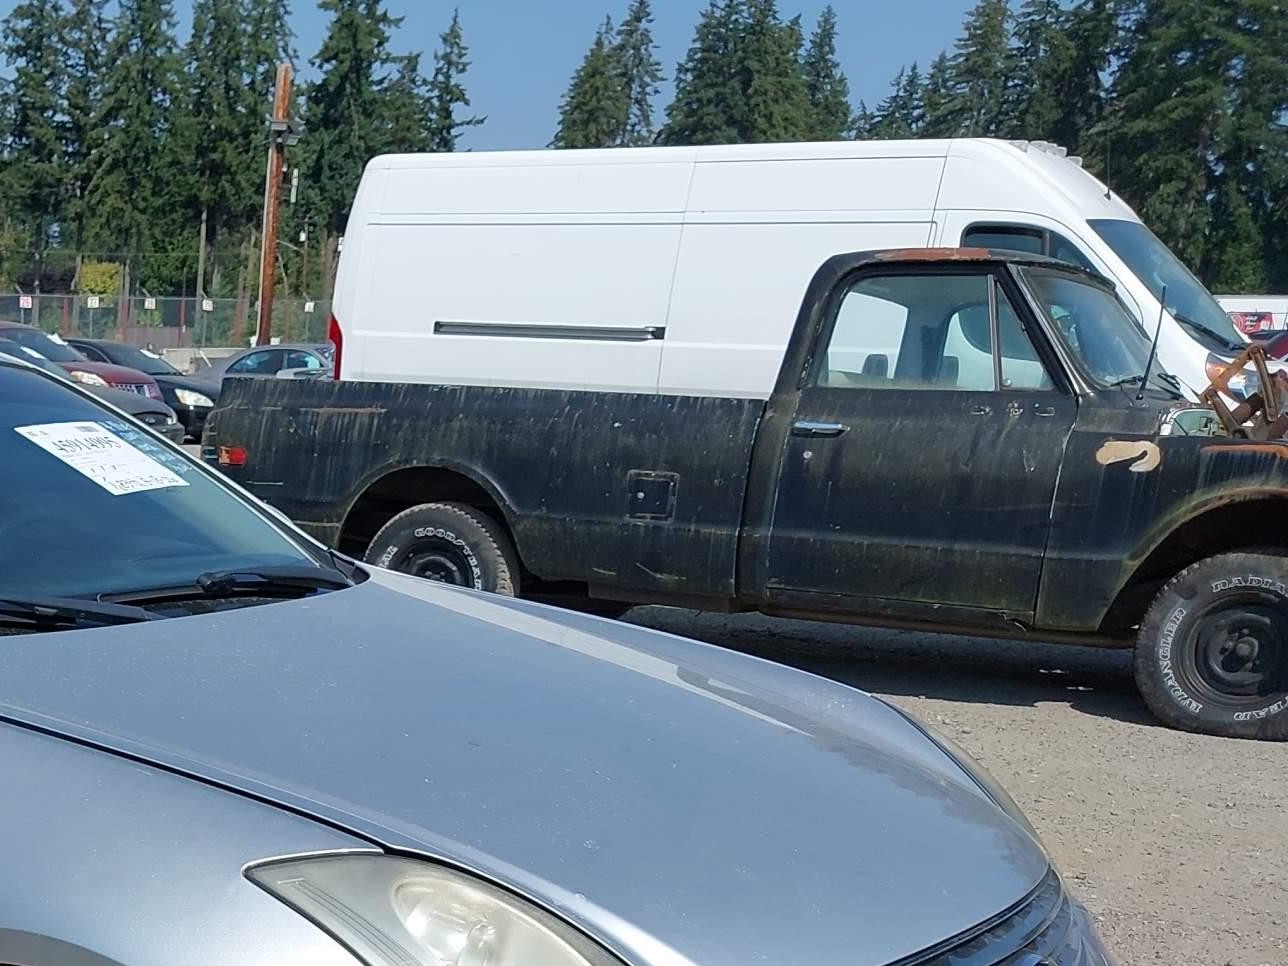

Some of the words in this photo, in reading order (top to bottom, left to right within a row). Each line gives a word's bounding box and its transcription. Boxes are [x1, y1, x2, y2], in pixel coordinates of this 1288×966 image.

[51, 436, 122, 453] 45914995
[1211, 576, 1288, 597] RADIA
[1159, 607, 1204, 713] WRANGLER
